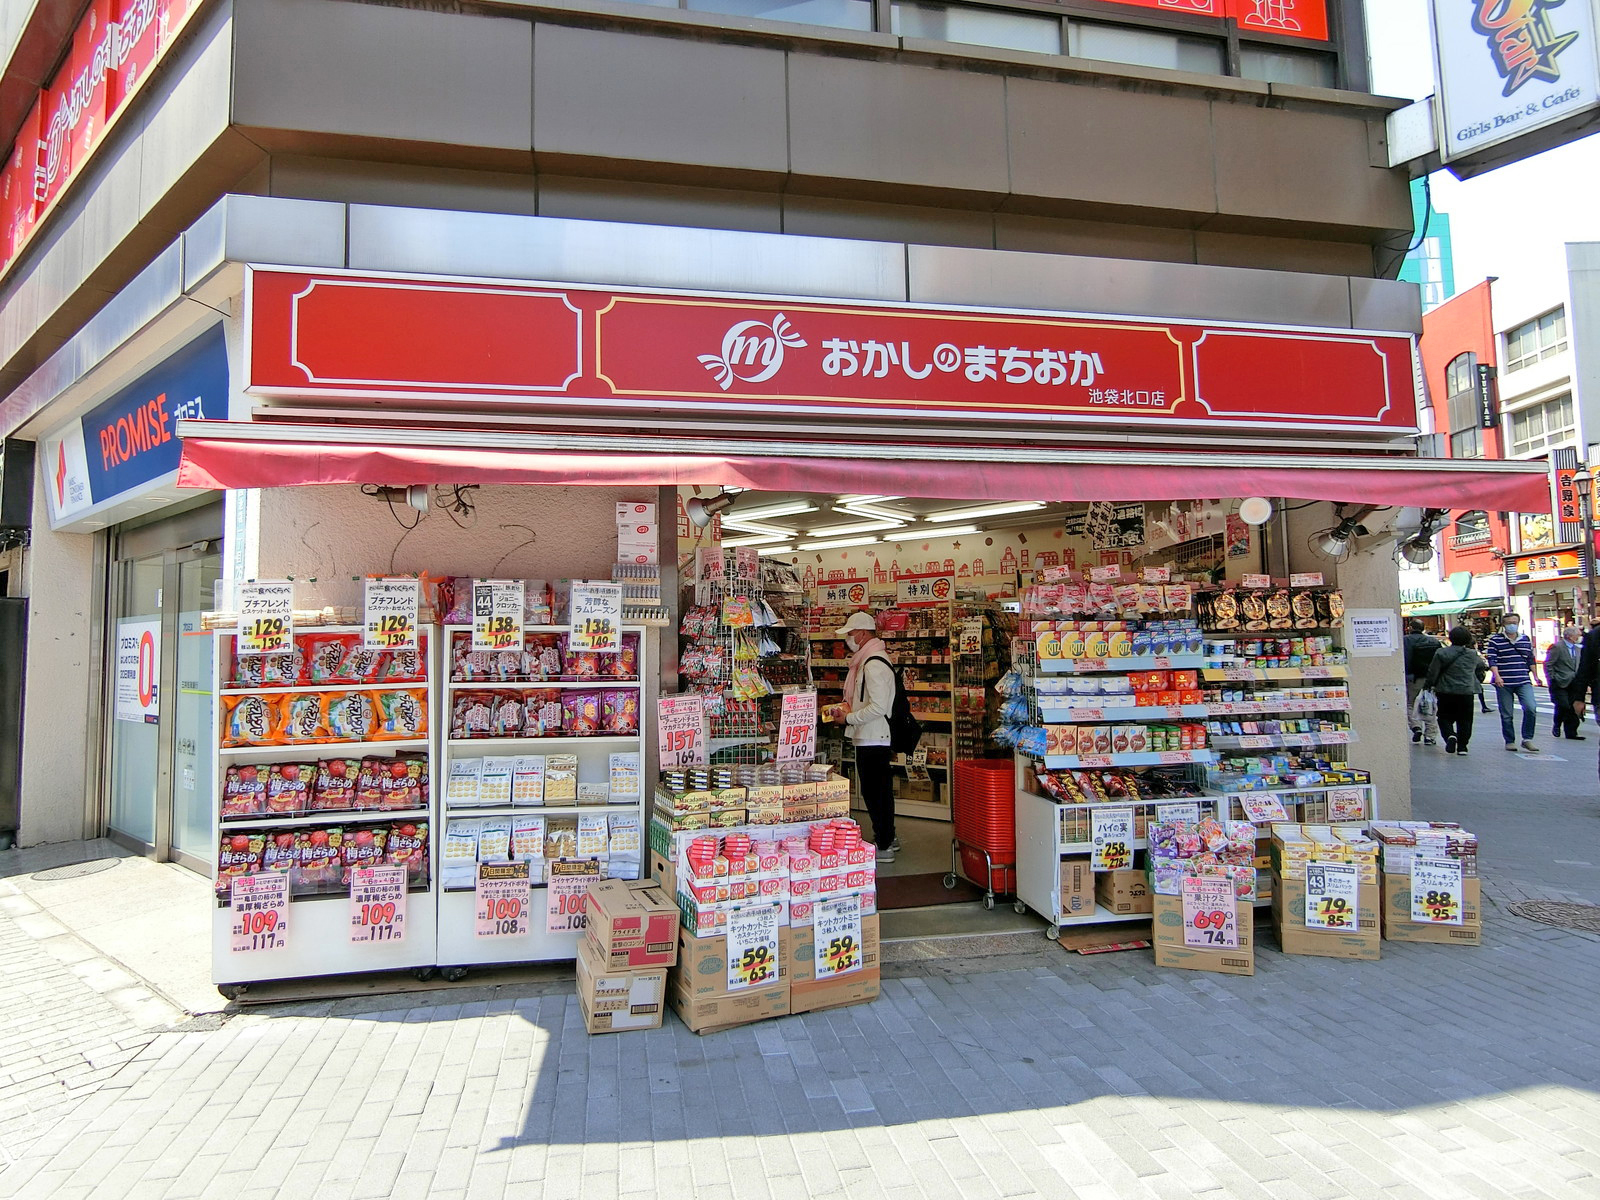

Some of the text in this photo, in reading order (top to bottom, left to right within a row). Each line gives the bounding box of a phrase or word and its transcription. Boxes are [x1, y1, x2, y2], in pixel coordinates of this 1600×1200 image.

[1457, 88, 1581, 141] Girls Bar & Cafe
[821, 337, 1104, 387] おかしのまちおか
[1088, 387, 1165, 407] 池袋北口店
[100, 393, 171, 471] PROMISE
[827, 589, 847, 600] 納得
[908, 584, 930, 596] 特別
[575, 606, 618, 614] ラムレーズン
[270, 779, 306, 792] 梅ざらめ
[318, 774, 353, 788] 梅ざらめ
[382, 777, 417, 789] 梅ざらめ
[821, 783, 846, 791] ALMOND
[227, 781, 265, 794] 梅ざらめ
[1098, 822, 1128, 832] パイの実
[390, 836, 421, 849] 梅ざらめ
[221, 852, 258, 864] 梅ざらめ
[301, 847, 338, 860] 梅ざらめ
[346, 847, 383, 860] 梅ざらめ
[1414, 871, 1460, 881] メルティーキッス
[1421, 879, 1454, 887] スリムキッス
[356, 893, 403, 903] 濃厚梅ざらめ
[1194, 894, 1225, 902] 果汁グミ
[236, 900, 285, 912] 濃厚梅ざらめ
[817, 913, 859, 927] キットカットミニ
[730, 921, 775, 933] キットカットミニ
